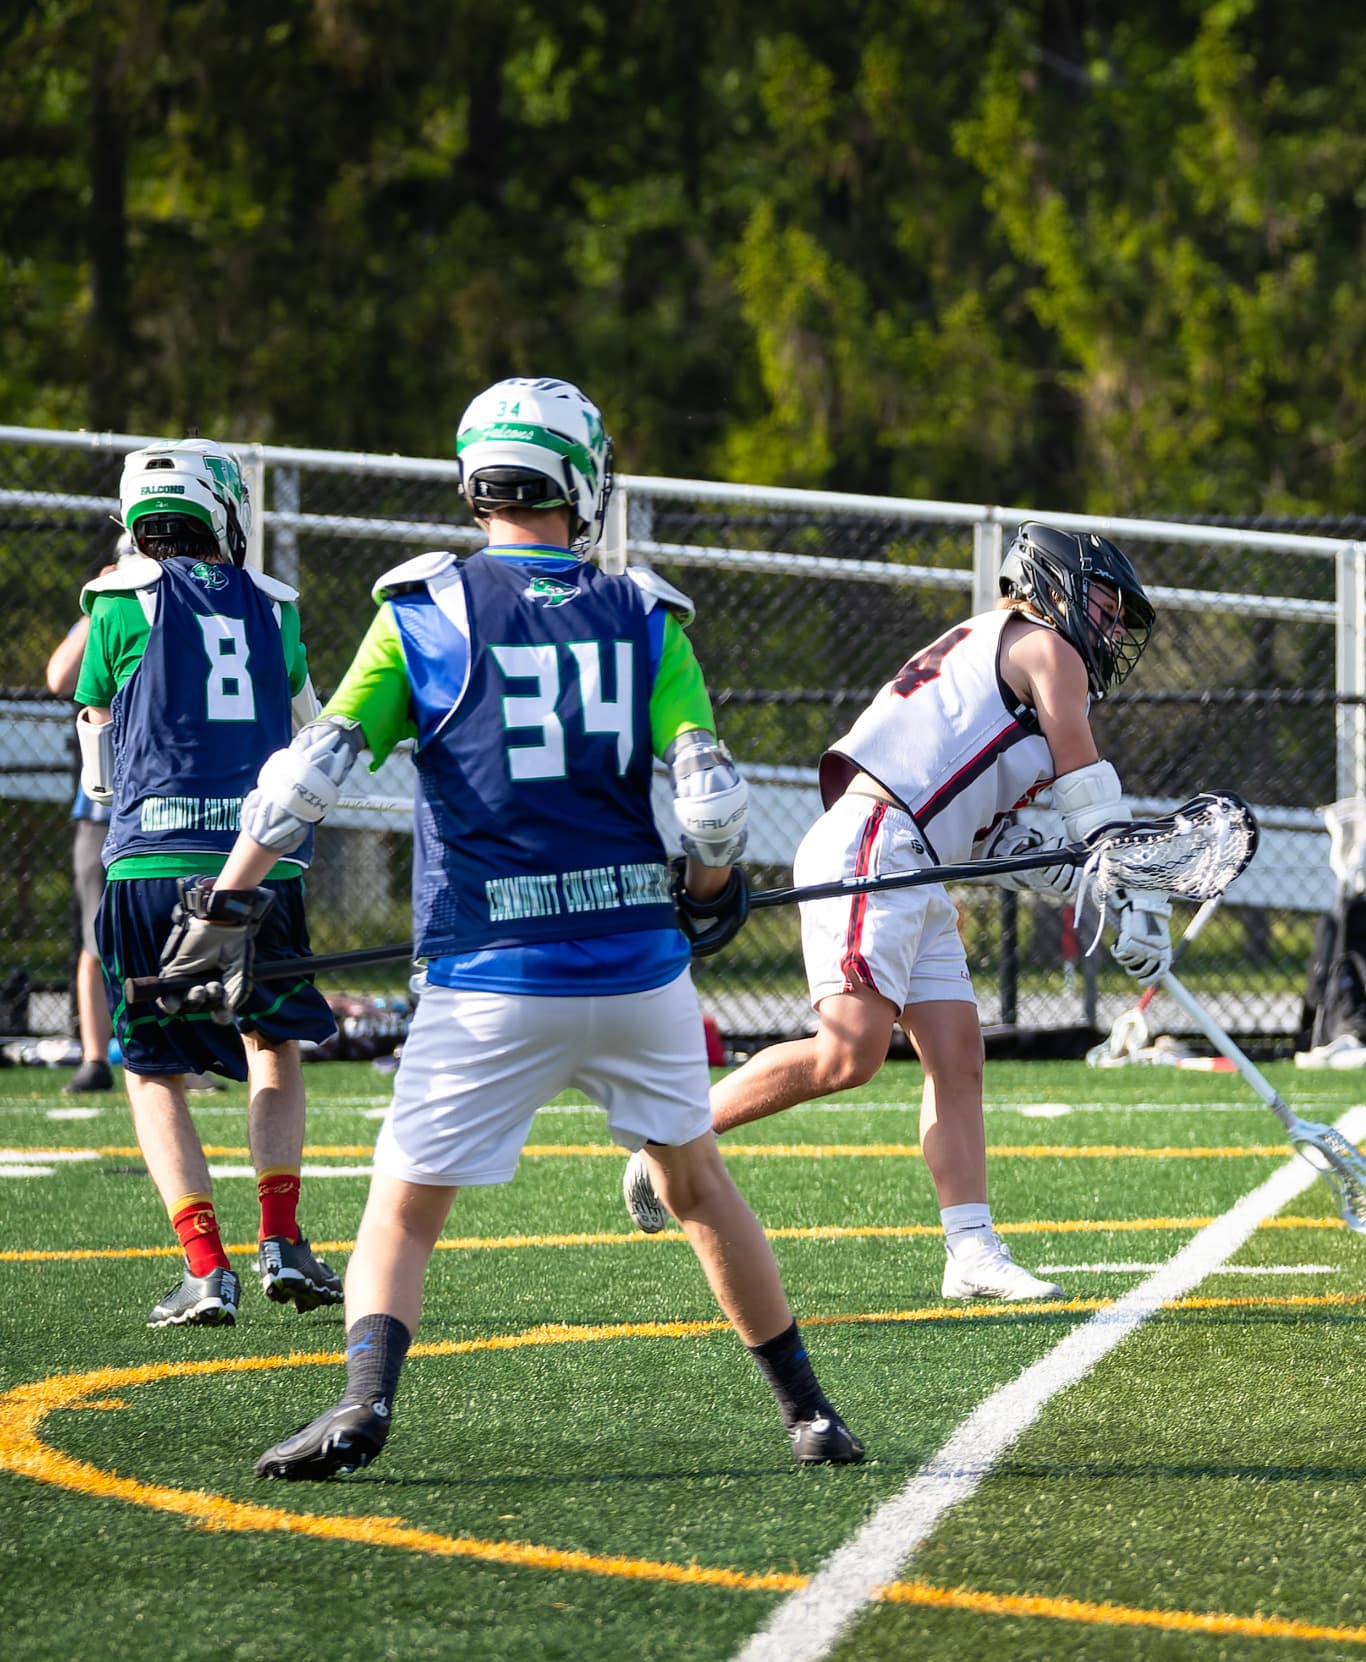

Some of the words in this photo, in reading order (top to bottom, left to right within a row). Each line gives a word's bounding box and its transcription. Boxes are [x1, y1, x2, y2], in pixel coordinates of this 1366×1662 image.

[497, 401, 521, 417] 34
[140, 485, 185, 496] FALCONS
[193, 611, 256, 722] 8
[486, 639, 634, 782] 34
[204, 797, 242, 831] CULTUR
[562, 866, 621, 913] CULTURE
